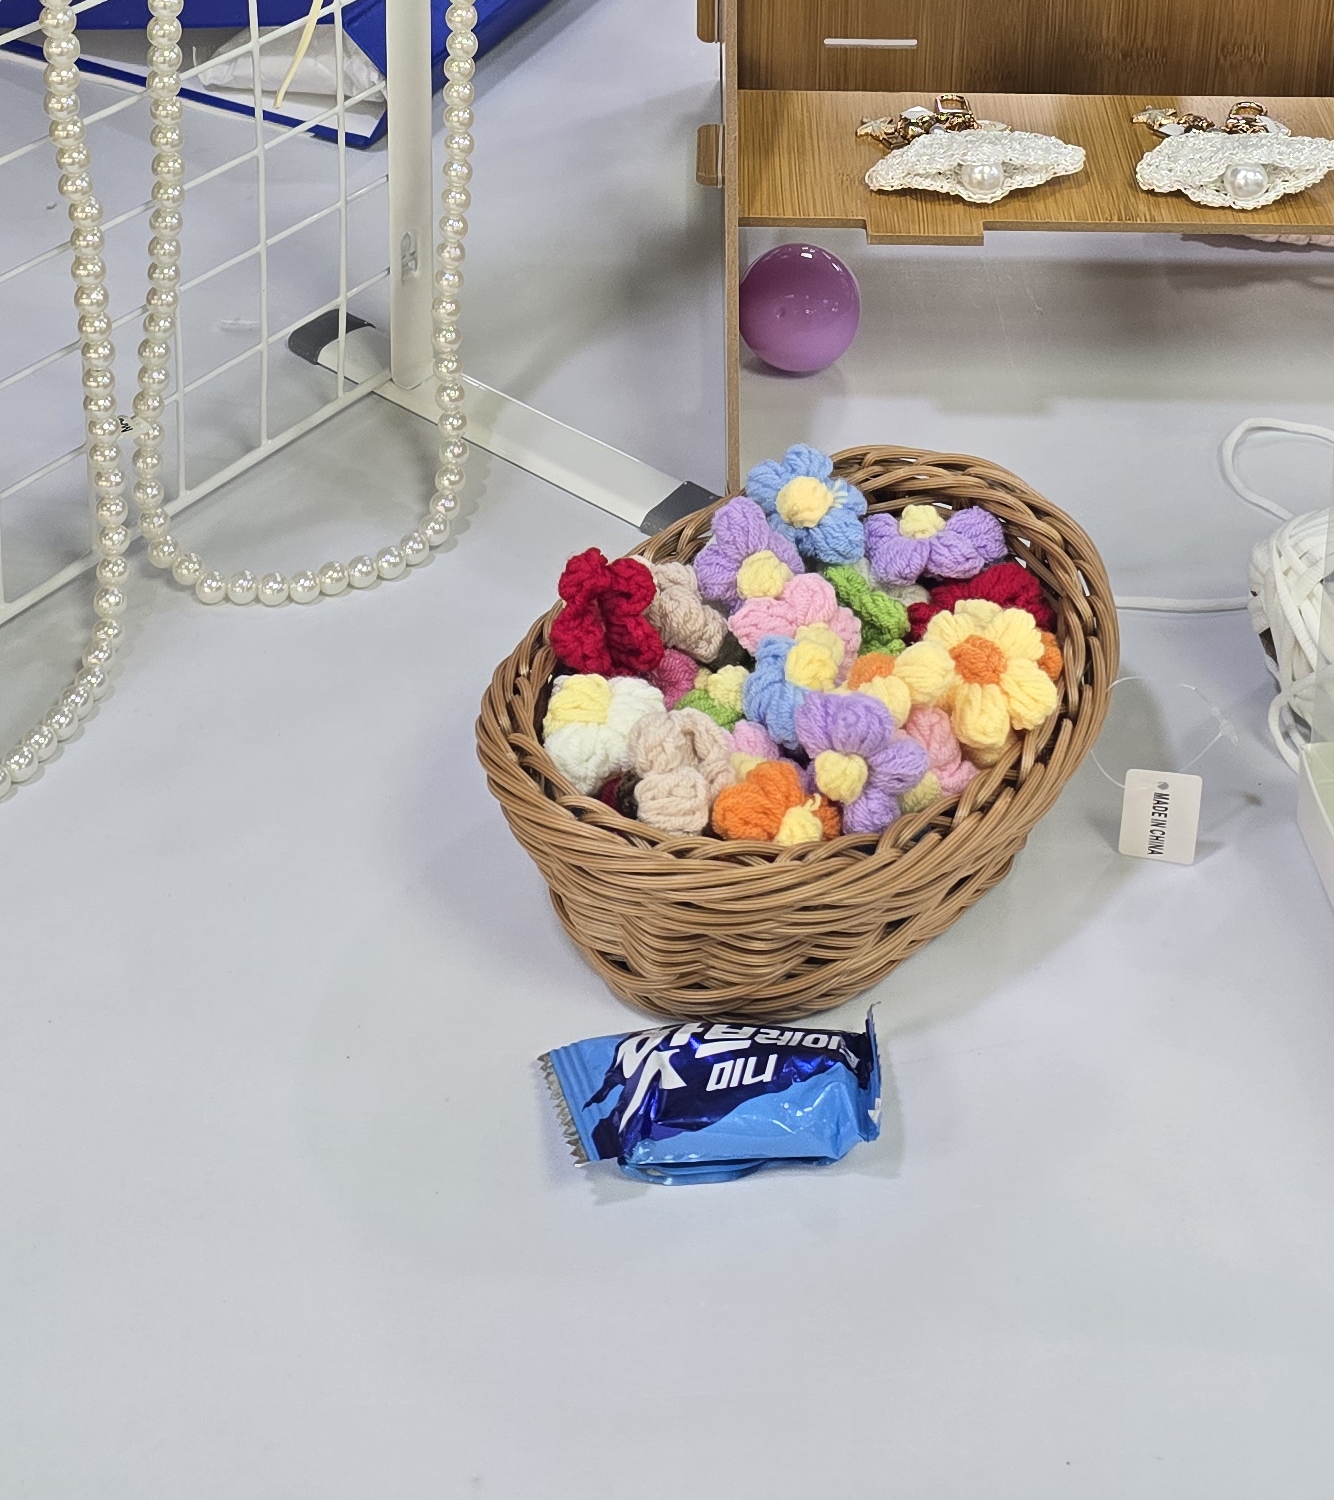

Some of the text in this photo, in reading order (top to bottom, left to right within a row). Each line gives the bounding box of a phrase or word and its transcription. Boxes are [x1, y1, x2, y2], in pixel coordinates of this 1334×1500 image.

[1147, 792, 1170, 855] MADE IN CHINA
[706, 1054, 779, 1092] 미니
